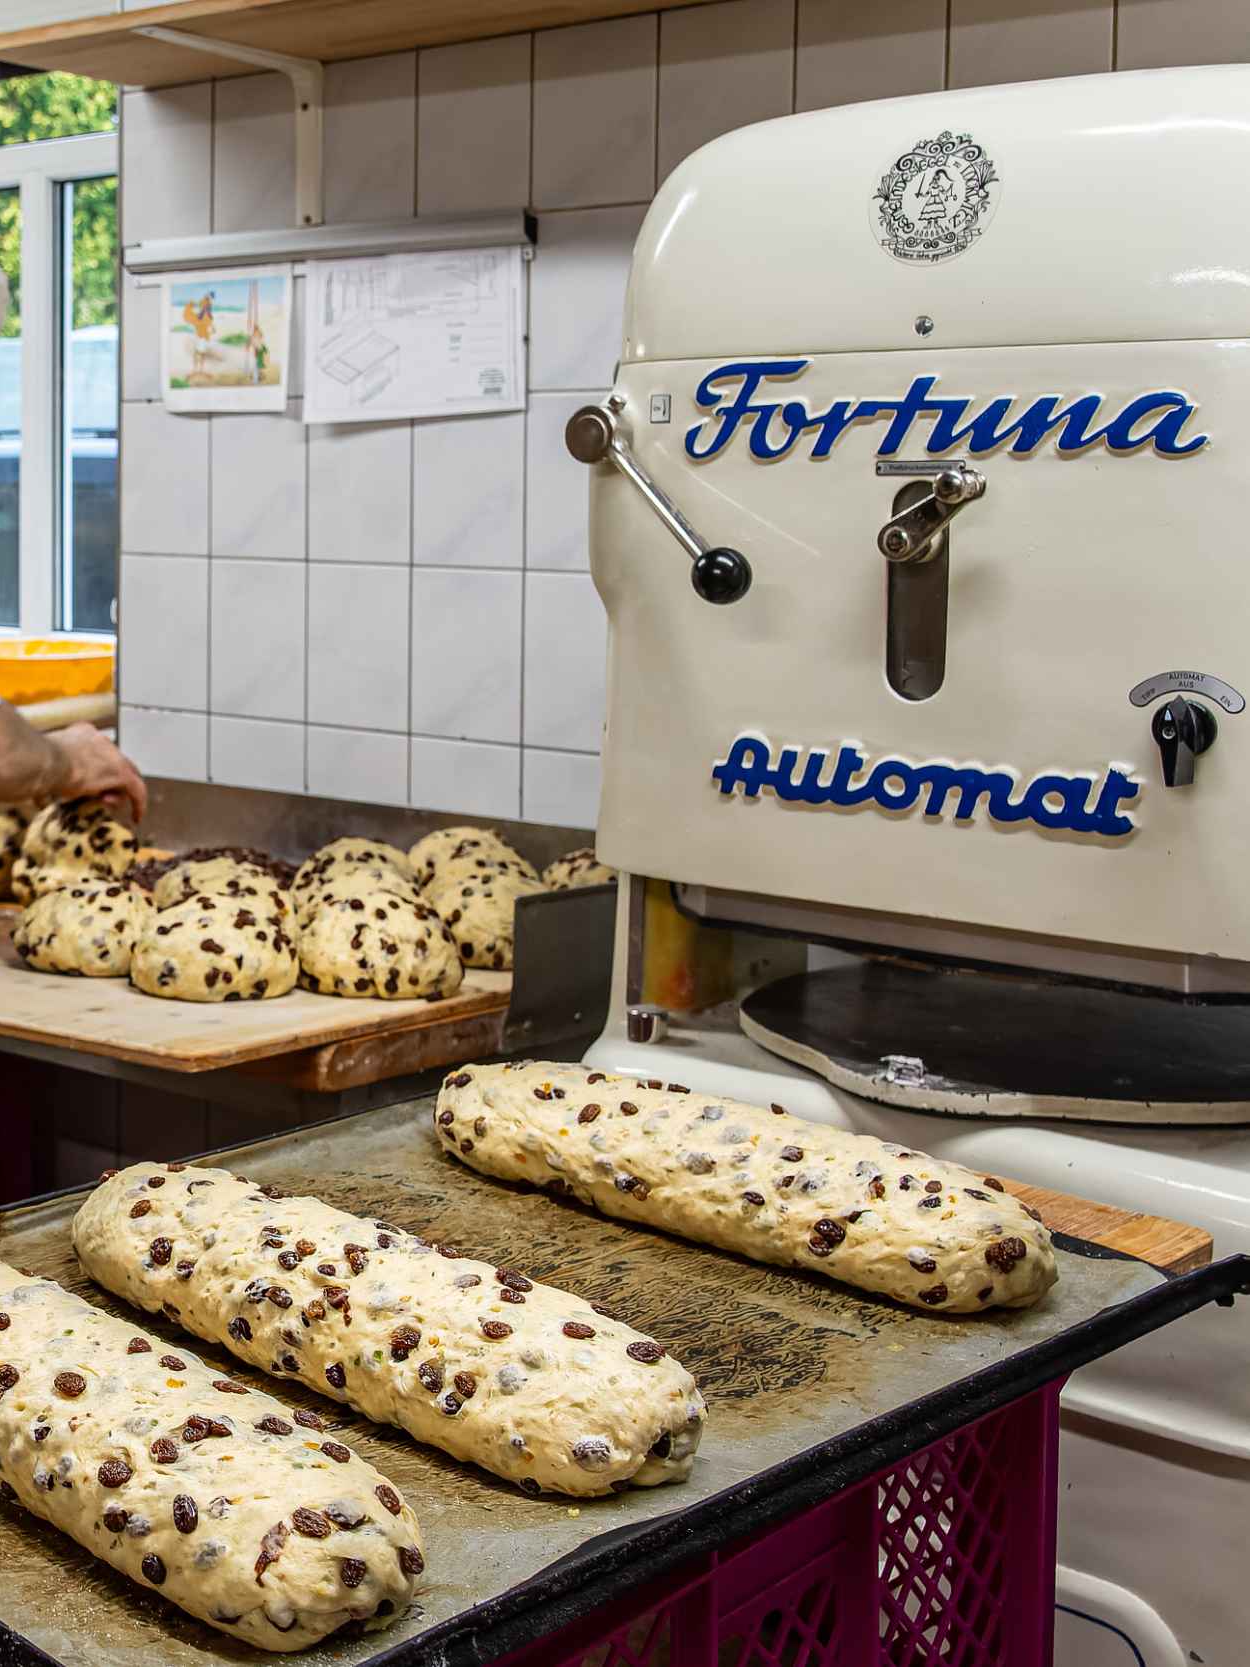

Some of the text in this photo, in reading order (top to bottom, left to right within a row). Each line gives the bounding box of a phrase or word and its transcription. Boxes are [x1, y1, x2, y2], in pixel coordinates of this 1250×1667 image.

[684, 358, 1211, 460] Fortuna
[1169, 672, 1205, 682] AUTOMAT
[1178, 681, 1194, 689] AUS
[712, 737, 1139, 836] Automat
